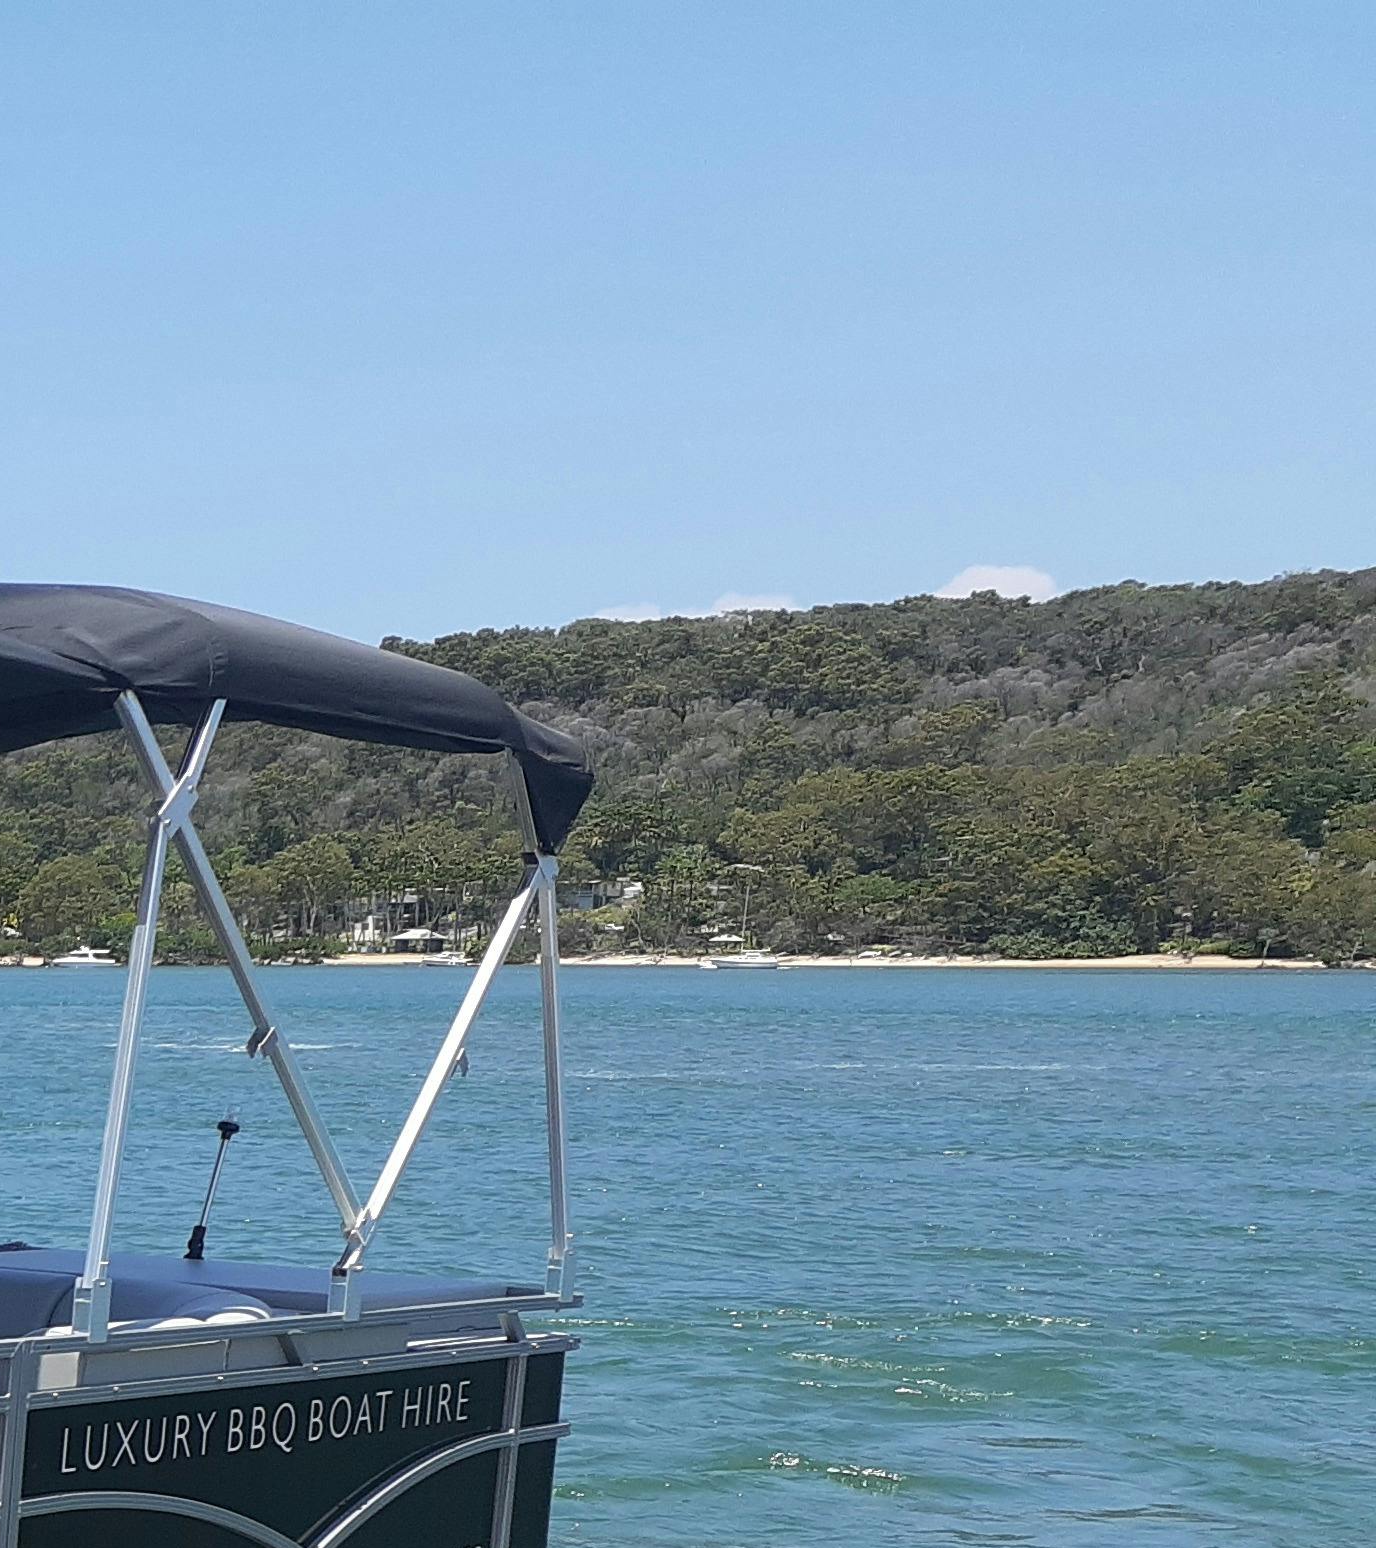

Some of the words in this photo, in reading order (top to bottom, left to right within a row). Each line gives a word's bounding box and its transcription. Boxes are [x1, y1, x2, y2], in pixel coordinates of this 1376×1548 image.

[61, 1411, 216, 1474] LUXURY
[227, 1402, 296, 1453] BBQ
[308, 1389, 394, 1442] BOAT
[401, 1380, 472, 1428] HIRE
